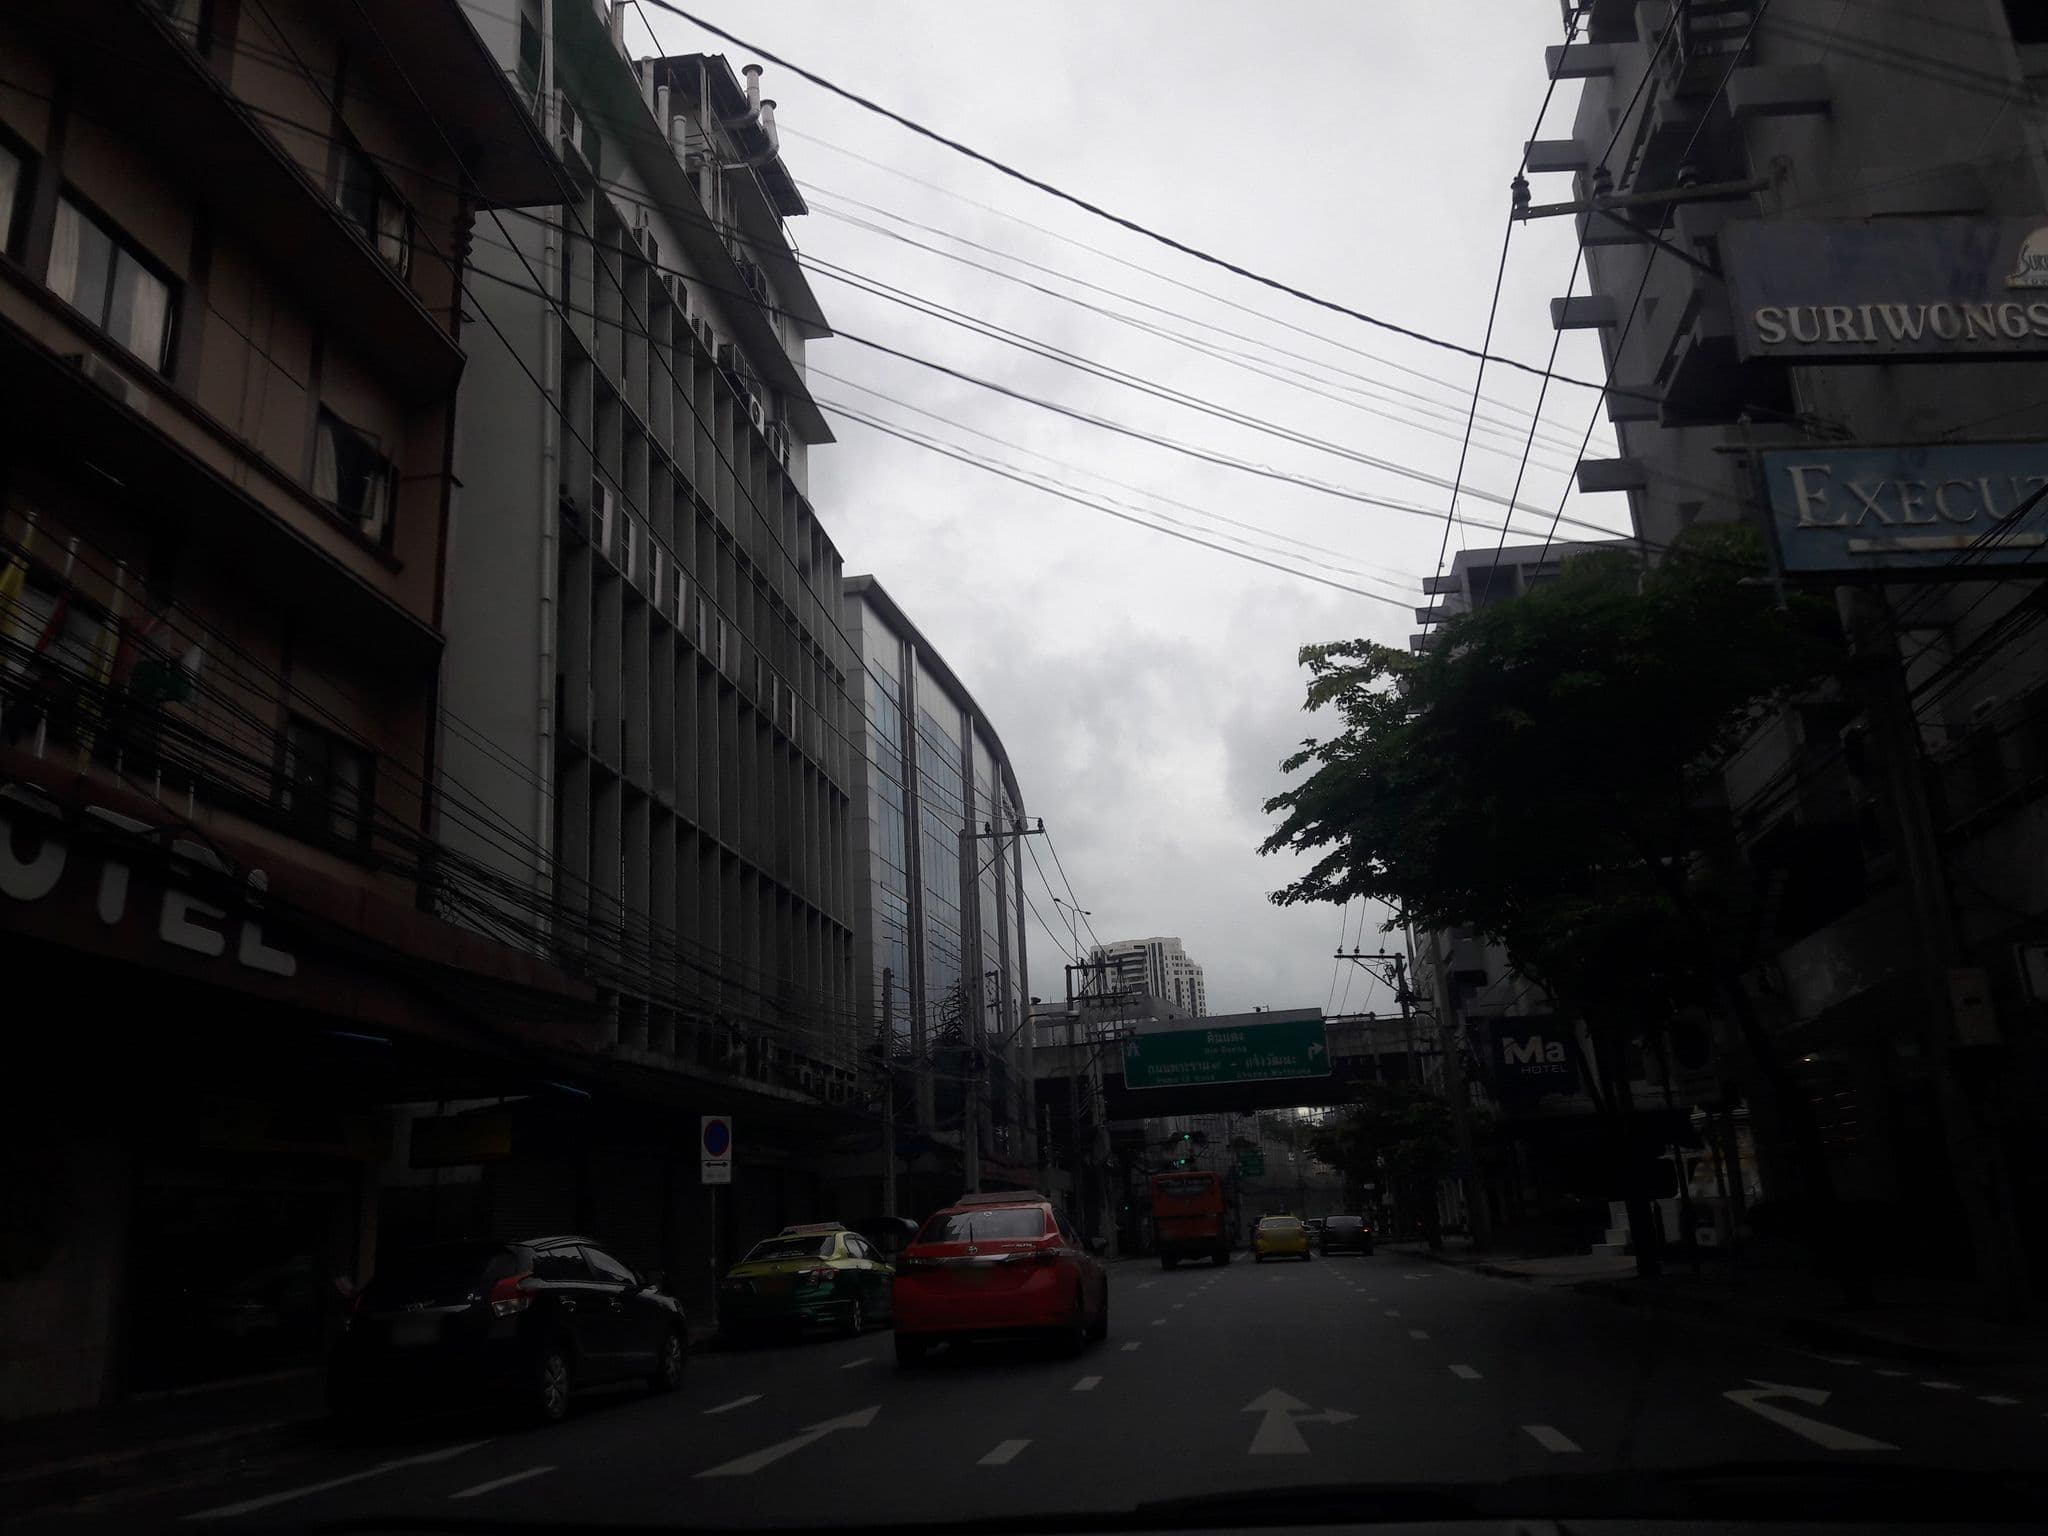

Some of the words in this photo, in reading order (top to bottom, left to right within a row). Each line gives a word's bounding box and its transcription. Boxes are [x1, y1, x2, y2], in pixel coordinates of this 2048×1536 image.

[1755, 303, 2048, 344] SURIWONGS
[1502, 1035, 1567, 1065] Ma
[1520, 1064, 1569, 1074] HOTEL
